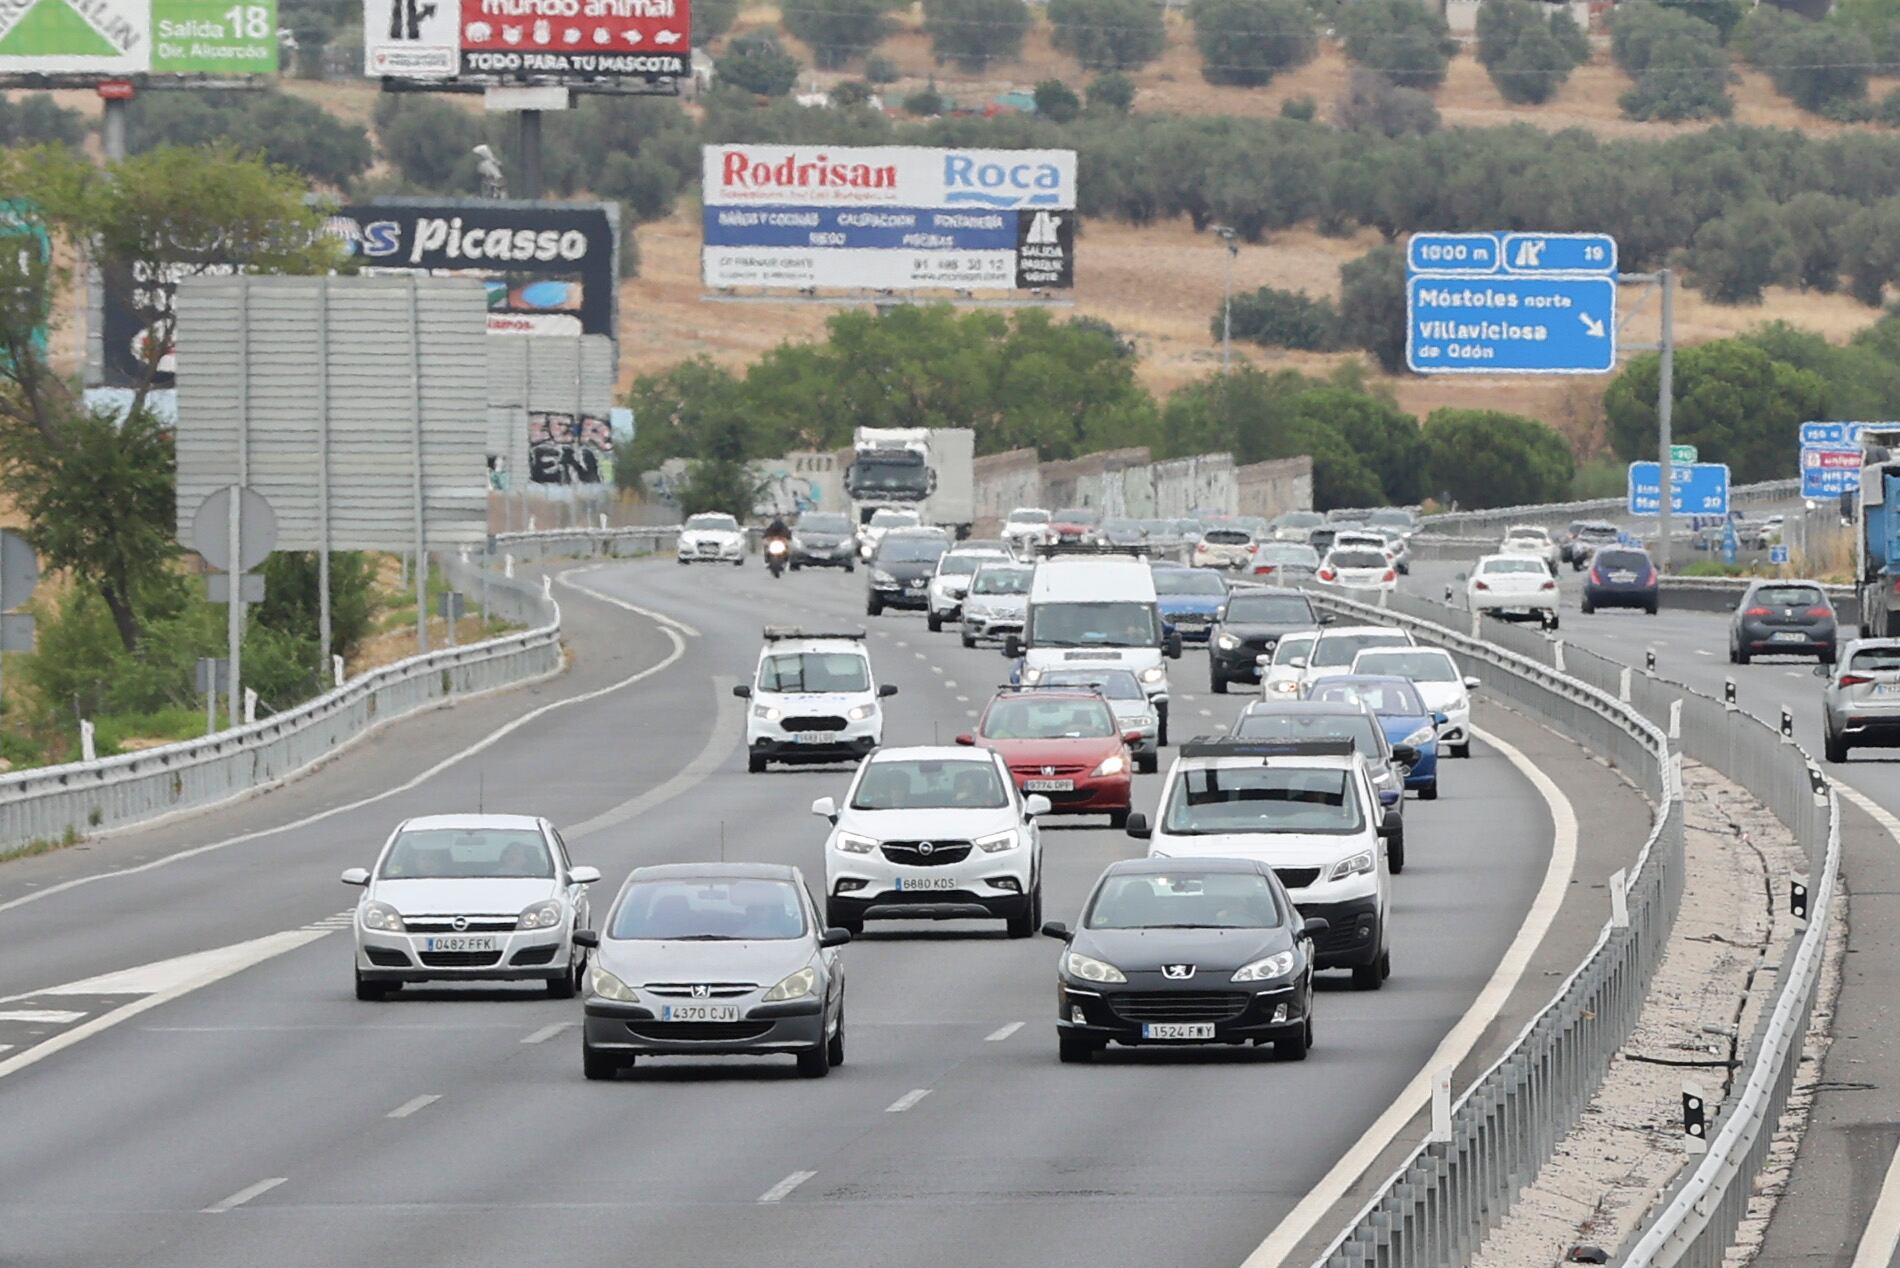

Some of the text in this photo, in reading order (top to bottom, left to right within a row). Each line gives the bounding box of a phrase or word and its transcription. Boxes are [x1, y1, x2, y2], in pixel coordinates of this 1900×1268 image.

[159, 5, 271, 39] Salida 18
[467, 53, 520, 71] TODO
[523, 53, 570, 71] PARA
[571, 54, 598, 71] TU
[599, 55, 683, 73] MASCOTA
[722, 151, 897, 189] Rodrisan
[944, 153, 1061, 190] Roca
[409, 216, 588, 264] Picasso
[1420, 243, 1489, 261] 1000 m
[1583, 245, 1605, 261] 19
[1417, 288, 1573, 308] Móstoles norte
[1418, 320, 1548, 340] Villaviciosa
[1417, 343, 1495, 359] de Odón
[903, 878, 955, 889] 6880 KDS
[435, 936, 491, 950] 0482 FFK
[672, 1007, 735, 1019] 4370 CJV
[1153, 1026, 1184, 1037] 1524
